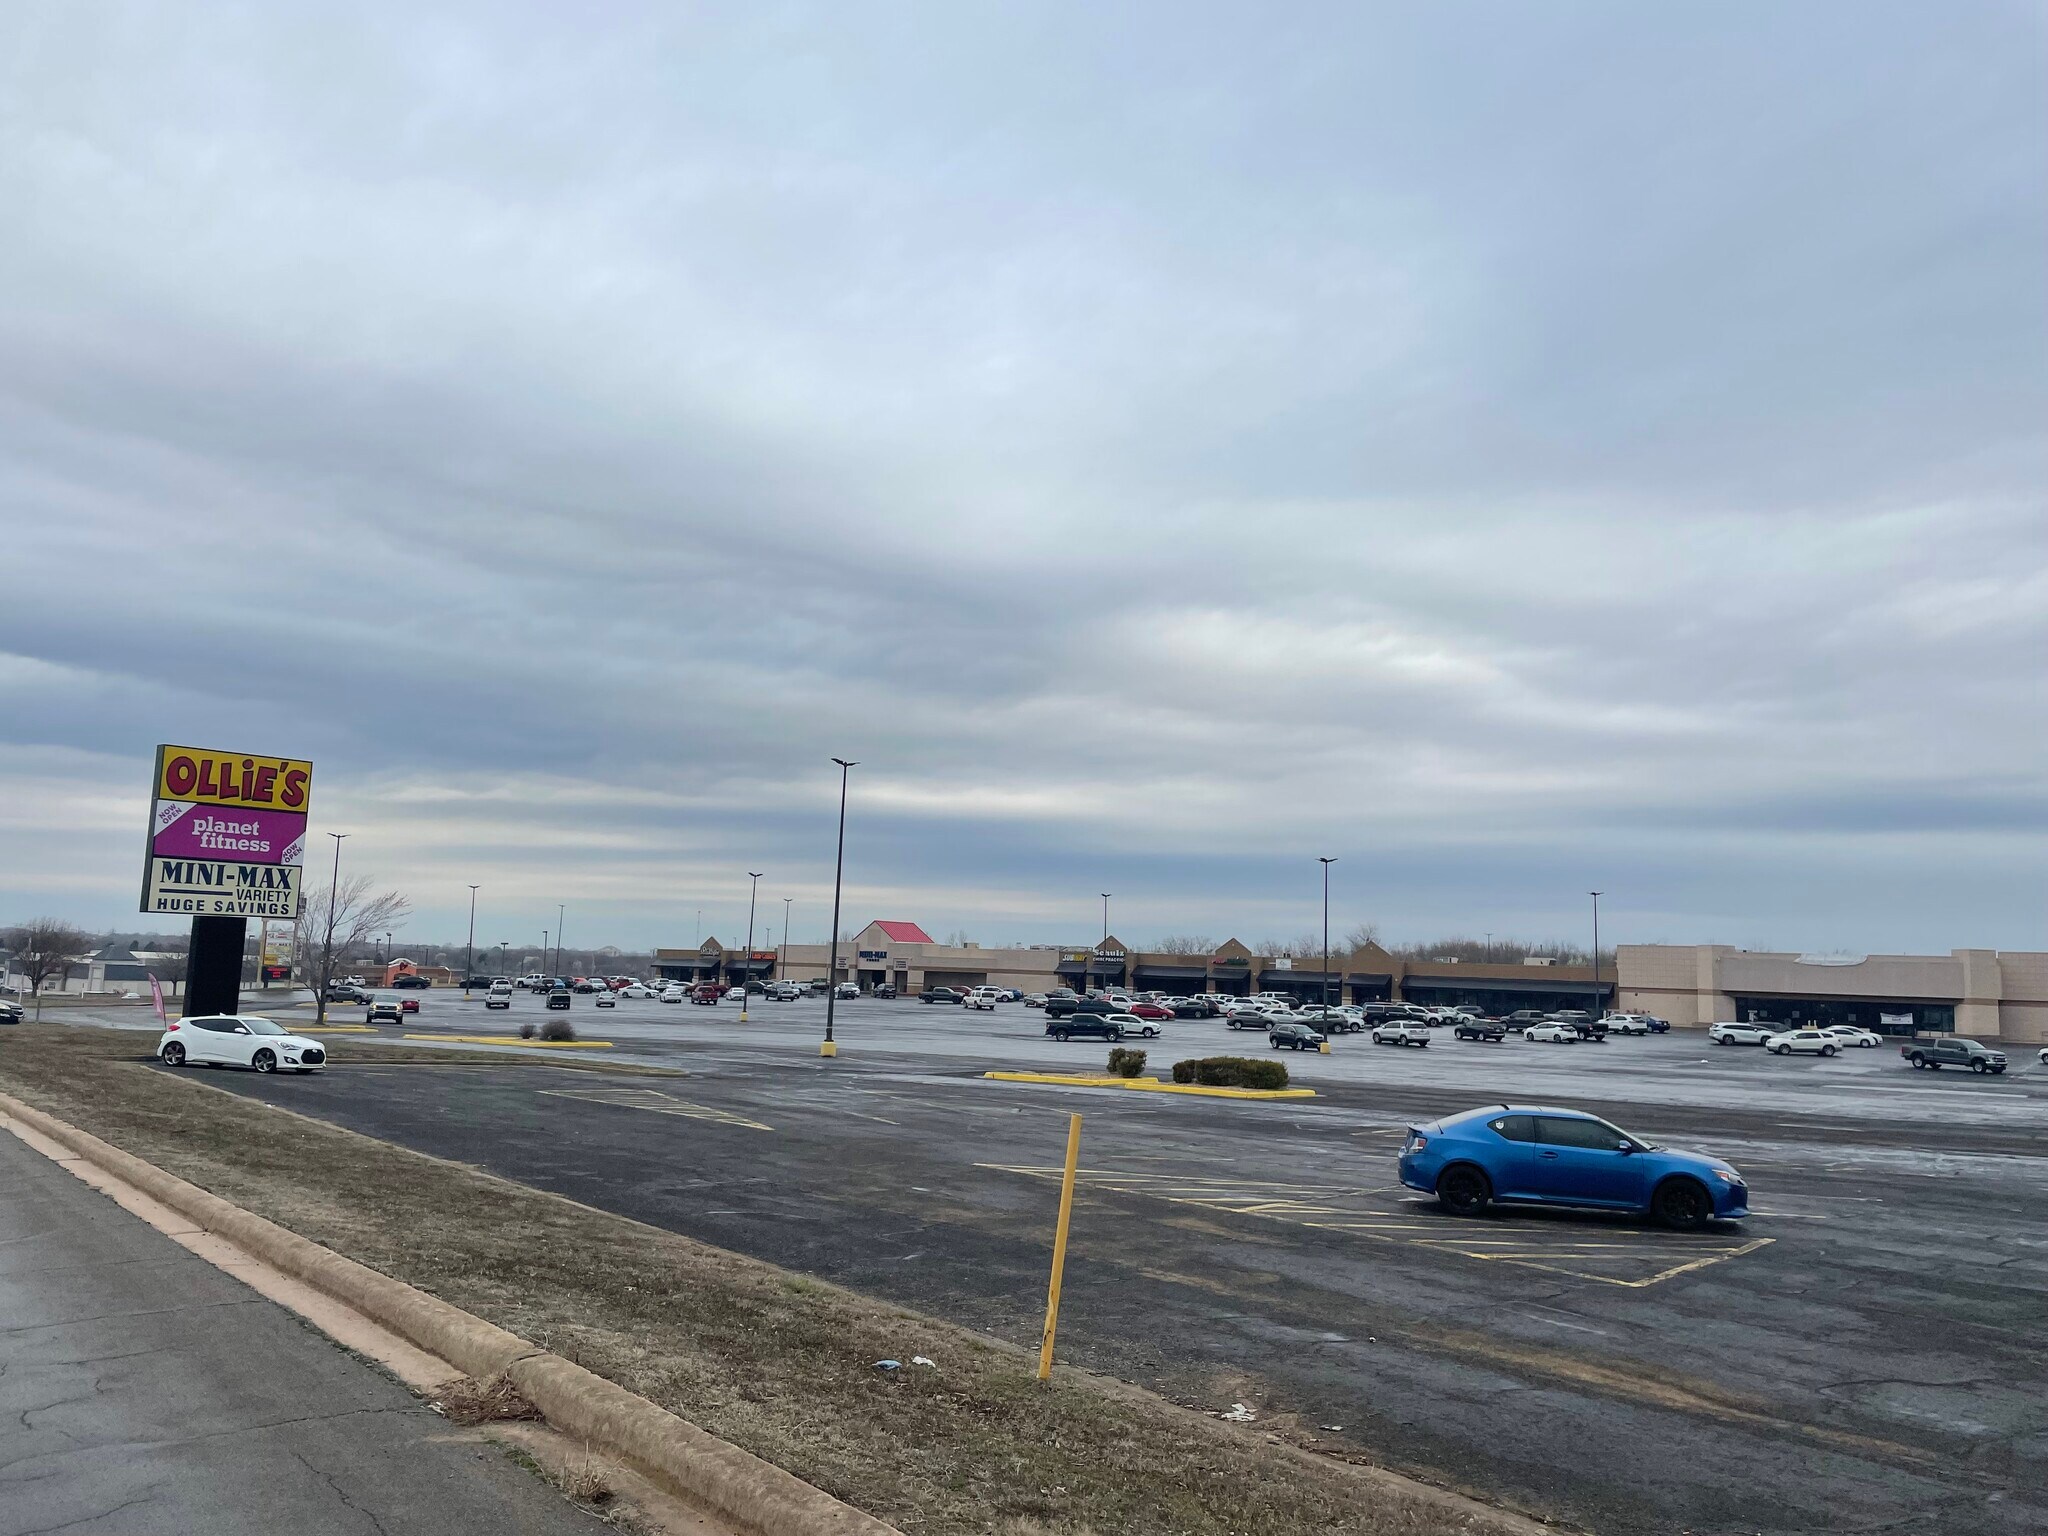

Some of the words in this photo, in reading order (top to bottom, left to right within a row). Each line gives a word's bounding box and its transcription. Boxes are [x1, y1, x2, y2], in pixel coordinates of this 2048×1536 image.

[158, 803, 177, 819] NOW
[162, 807, 182, 824] OPEN
[192, 816, 260, 836] planet
[200, 833, 270, 852] fitness
[282, 843, 298, 858] NOW
[284, 846, 303, 863] OPEN
[160, 861, 293, 889] MINI-MAX
[236, 888, 292, 903] VARIETY
[157, 898, 205, 912] HUGE
[214, 901, 290, 915] SAVINGS
